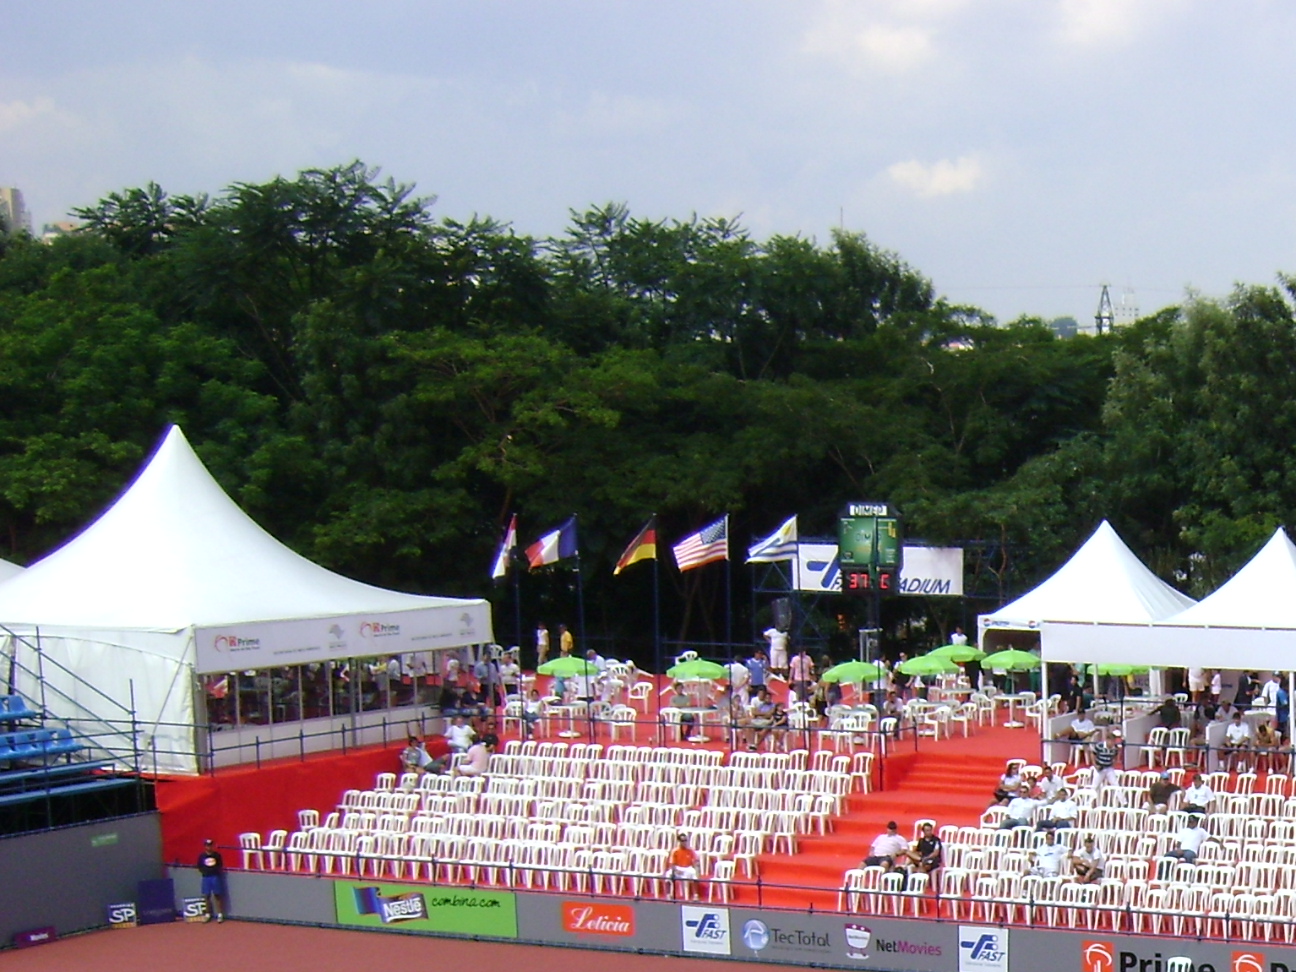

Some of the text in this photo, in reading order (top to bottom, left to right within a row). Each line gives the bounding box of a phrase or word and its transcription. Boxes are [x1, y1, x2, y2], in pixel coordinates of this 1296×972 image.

[849, 573, 869, 589] 37
[900, 578, 951, 594] ADIUM
[570, 906, 630, 933] Leticia
[702, 928, 728, 940] FAST
[771, 928, 831, 947] TecTotal
[876, 938, 942, 956] NetMovies
[978, 951, 1005, 962] FAST
